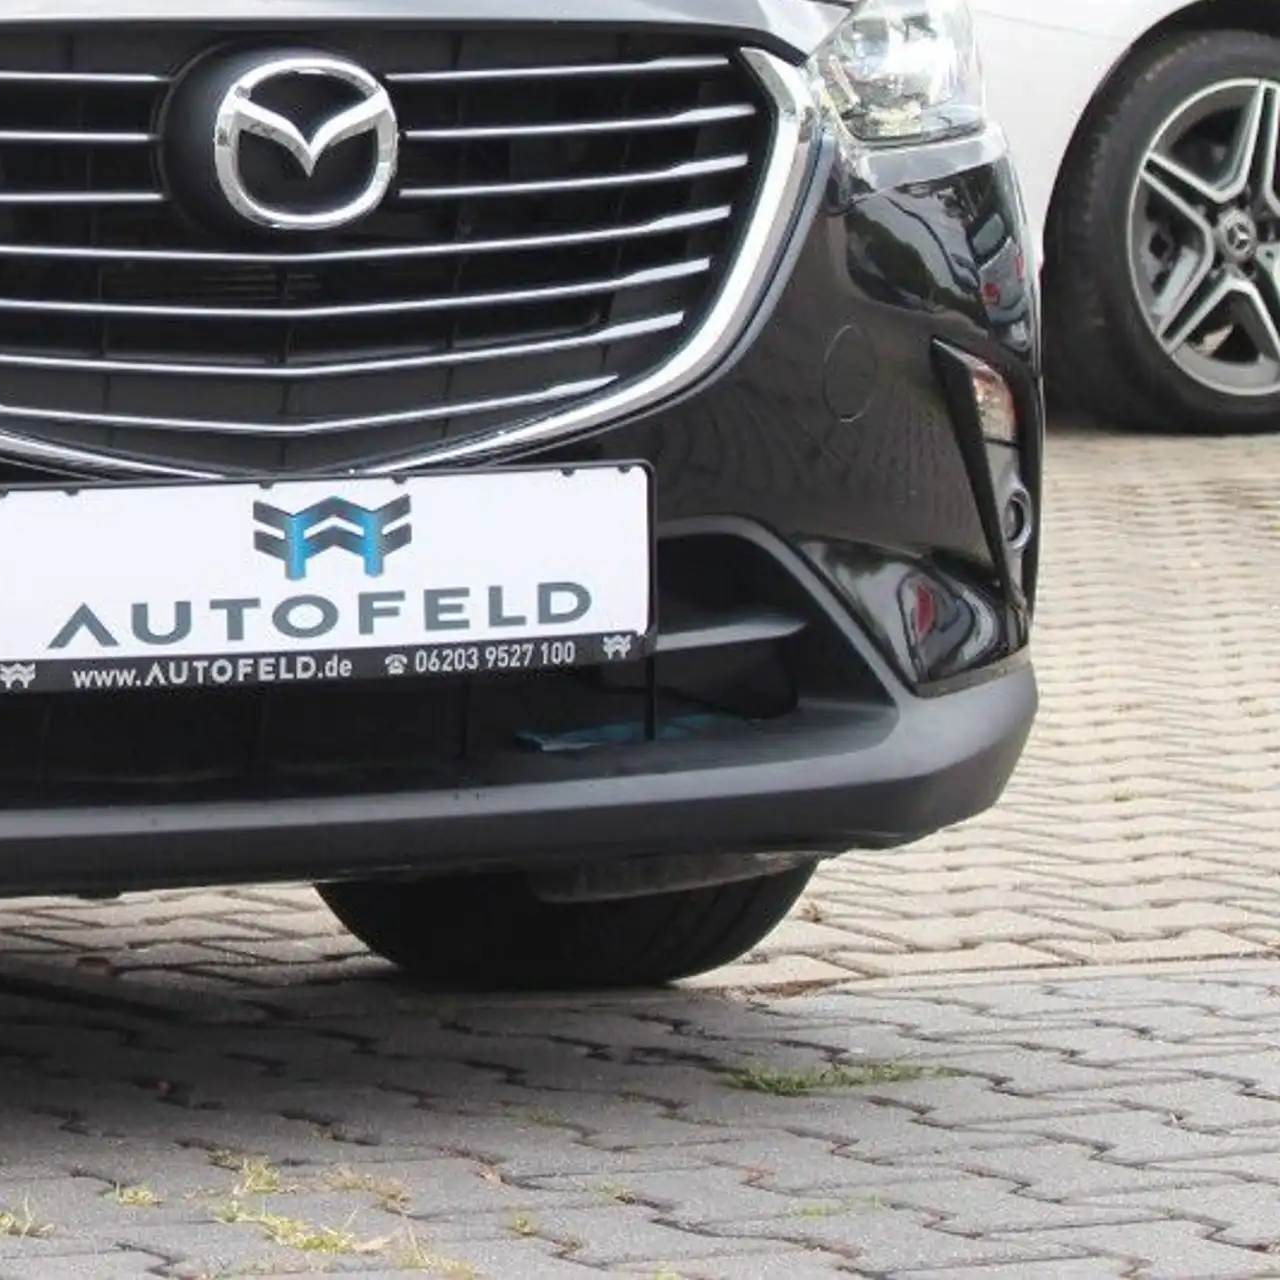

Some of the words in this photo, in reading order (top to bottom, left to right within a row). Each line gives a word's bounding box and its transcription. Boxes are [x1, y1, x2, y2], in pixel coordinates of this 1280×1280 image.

[46, 581, 592, 649] AUTOFELD
[72, 653, 353, 689] www.AUTOFELD.de
[414, 648, 479, 673] 06203
[485, 644, 535, 669] 9527
[541, 640, 576, 665] 100
